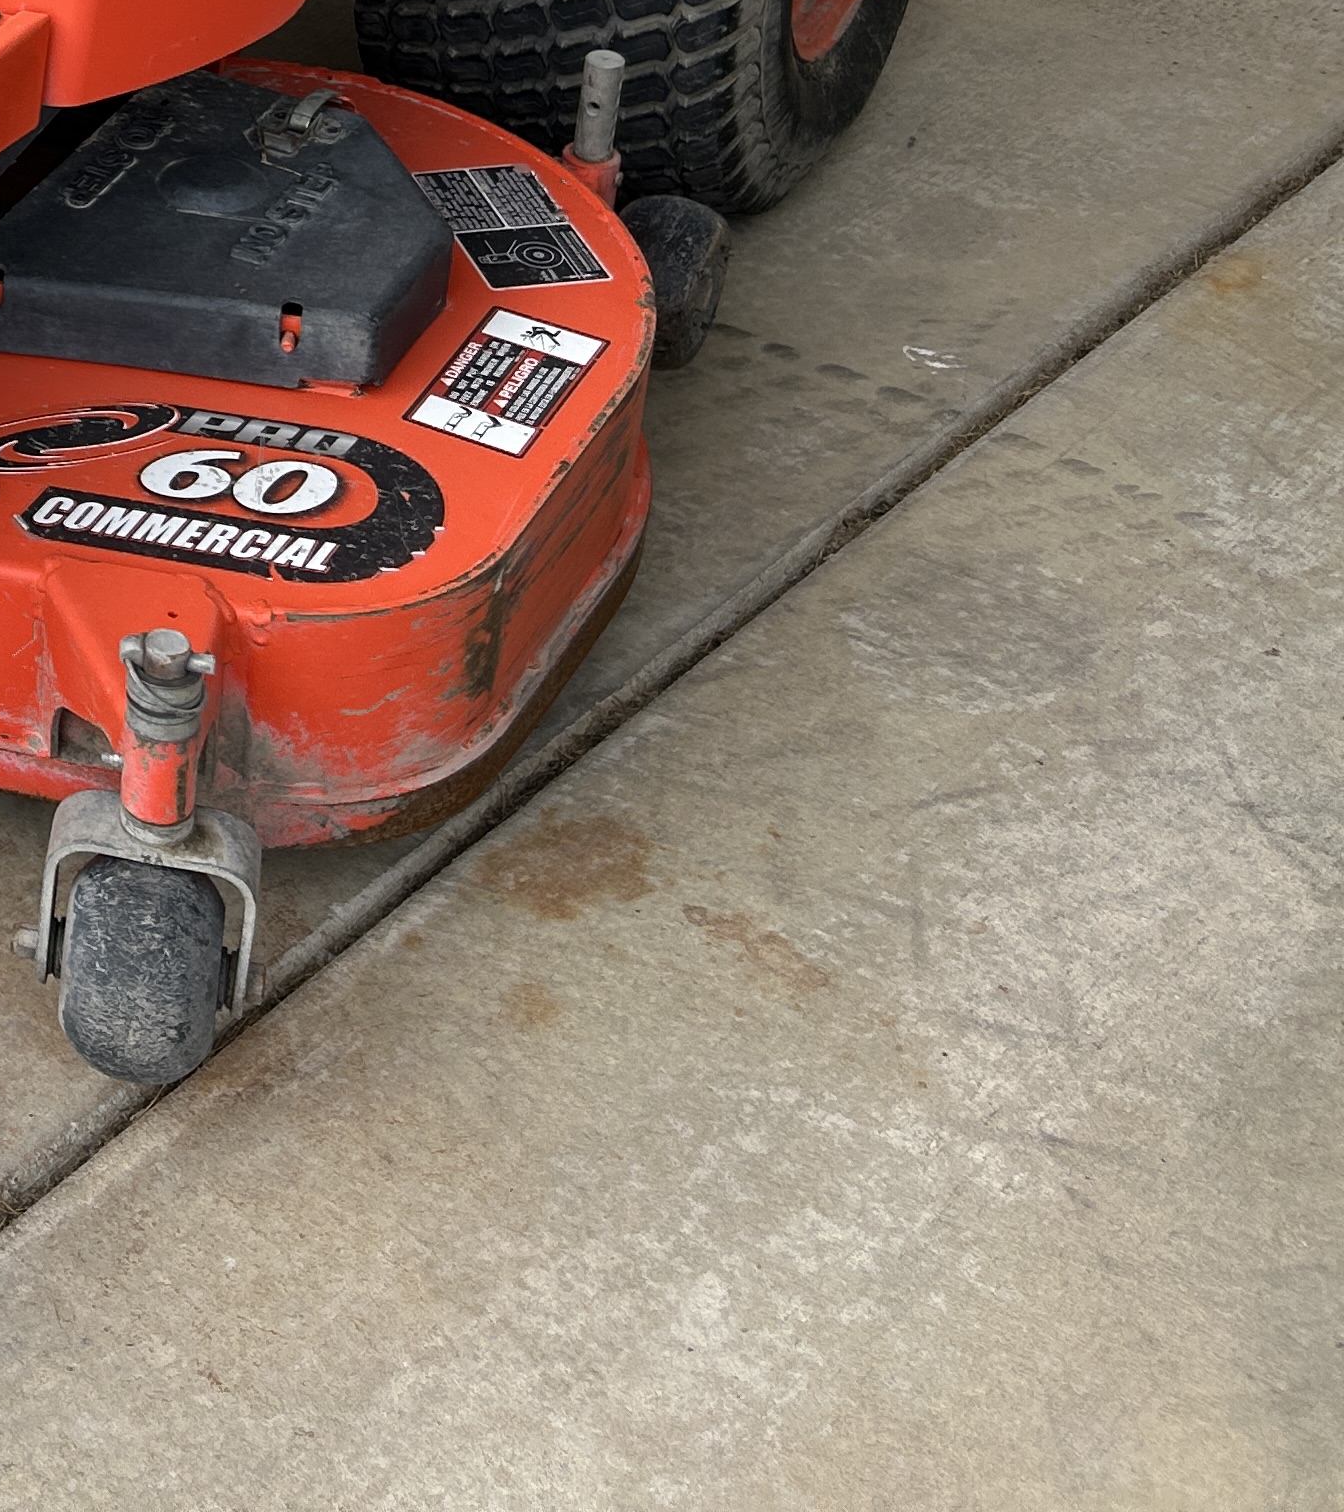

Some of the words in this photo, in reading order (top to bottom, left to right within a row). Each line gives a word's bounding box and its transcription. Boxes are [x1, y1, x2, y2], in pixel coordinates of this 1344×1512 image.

[445, 341, 484, 379] DANGER
[499, 357, 540, 400] PELIGRO
[180, 410, 358, 456] PRO
[140, 449, 339, 515] 60
[32, 495, 339, 573] COMMERCIAL
